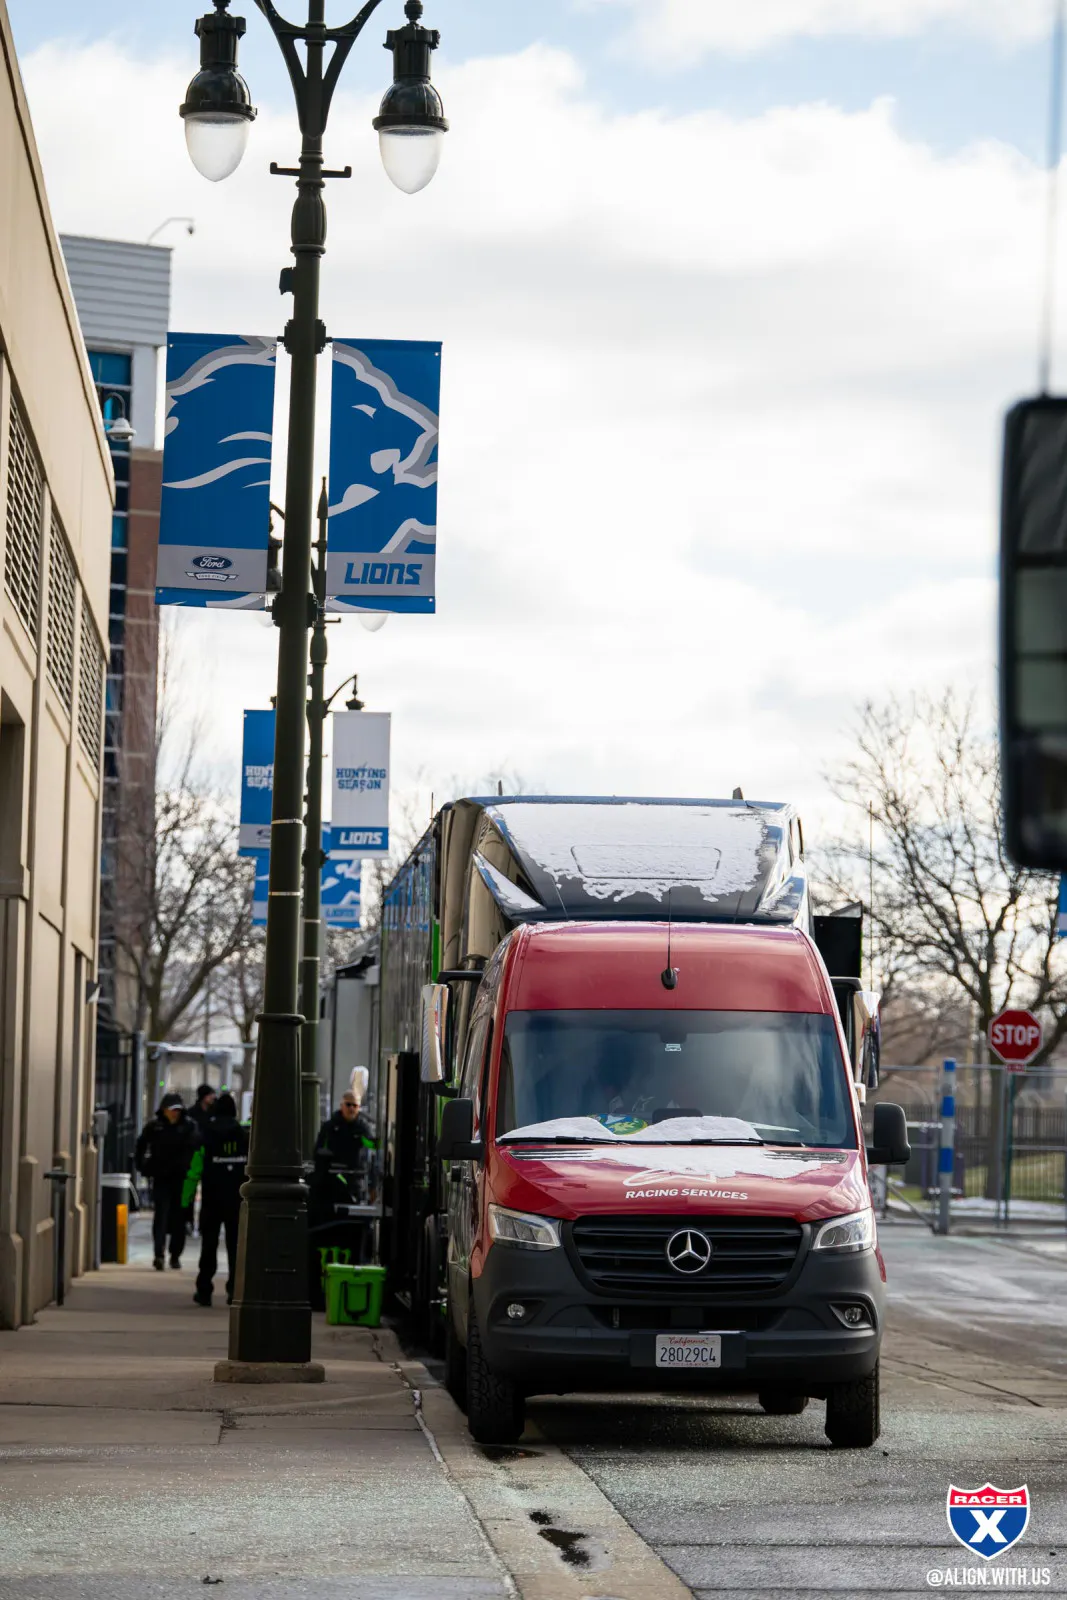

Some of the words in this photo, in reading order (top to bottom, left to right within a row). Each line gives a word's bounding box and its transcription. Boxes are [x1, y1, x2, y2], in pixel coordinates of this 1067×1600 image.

[199, 556, 225, 568] Ford
[344, 562, 423, 585] LIONS
[336, 766, 386, 779] HUNTING
[338, 779, 381, 791] SEASON
[340, 831, 383, 845] LIONS
[992, 1023, 1039, 1046] STOP
[625, 1188, 678, 1199] RACING
[680, 1188, 749, 1200] SERVICES
[668, 1336, 709, 1346] California
[660, 1346, 716, 1362] 28029C4
